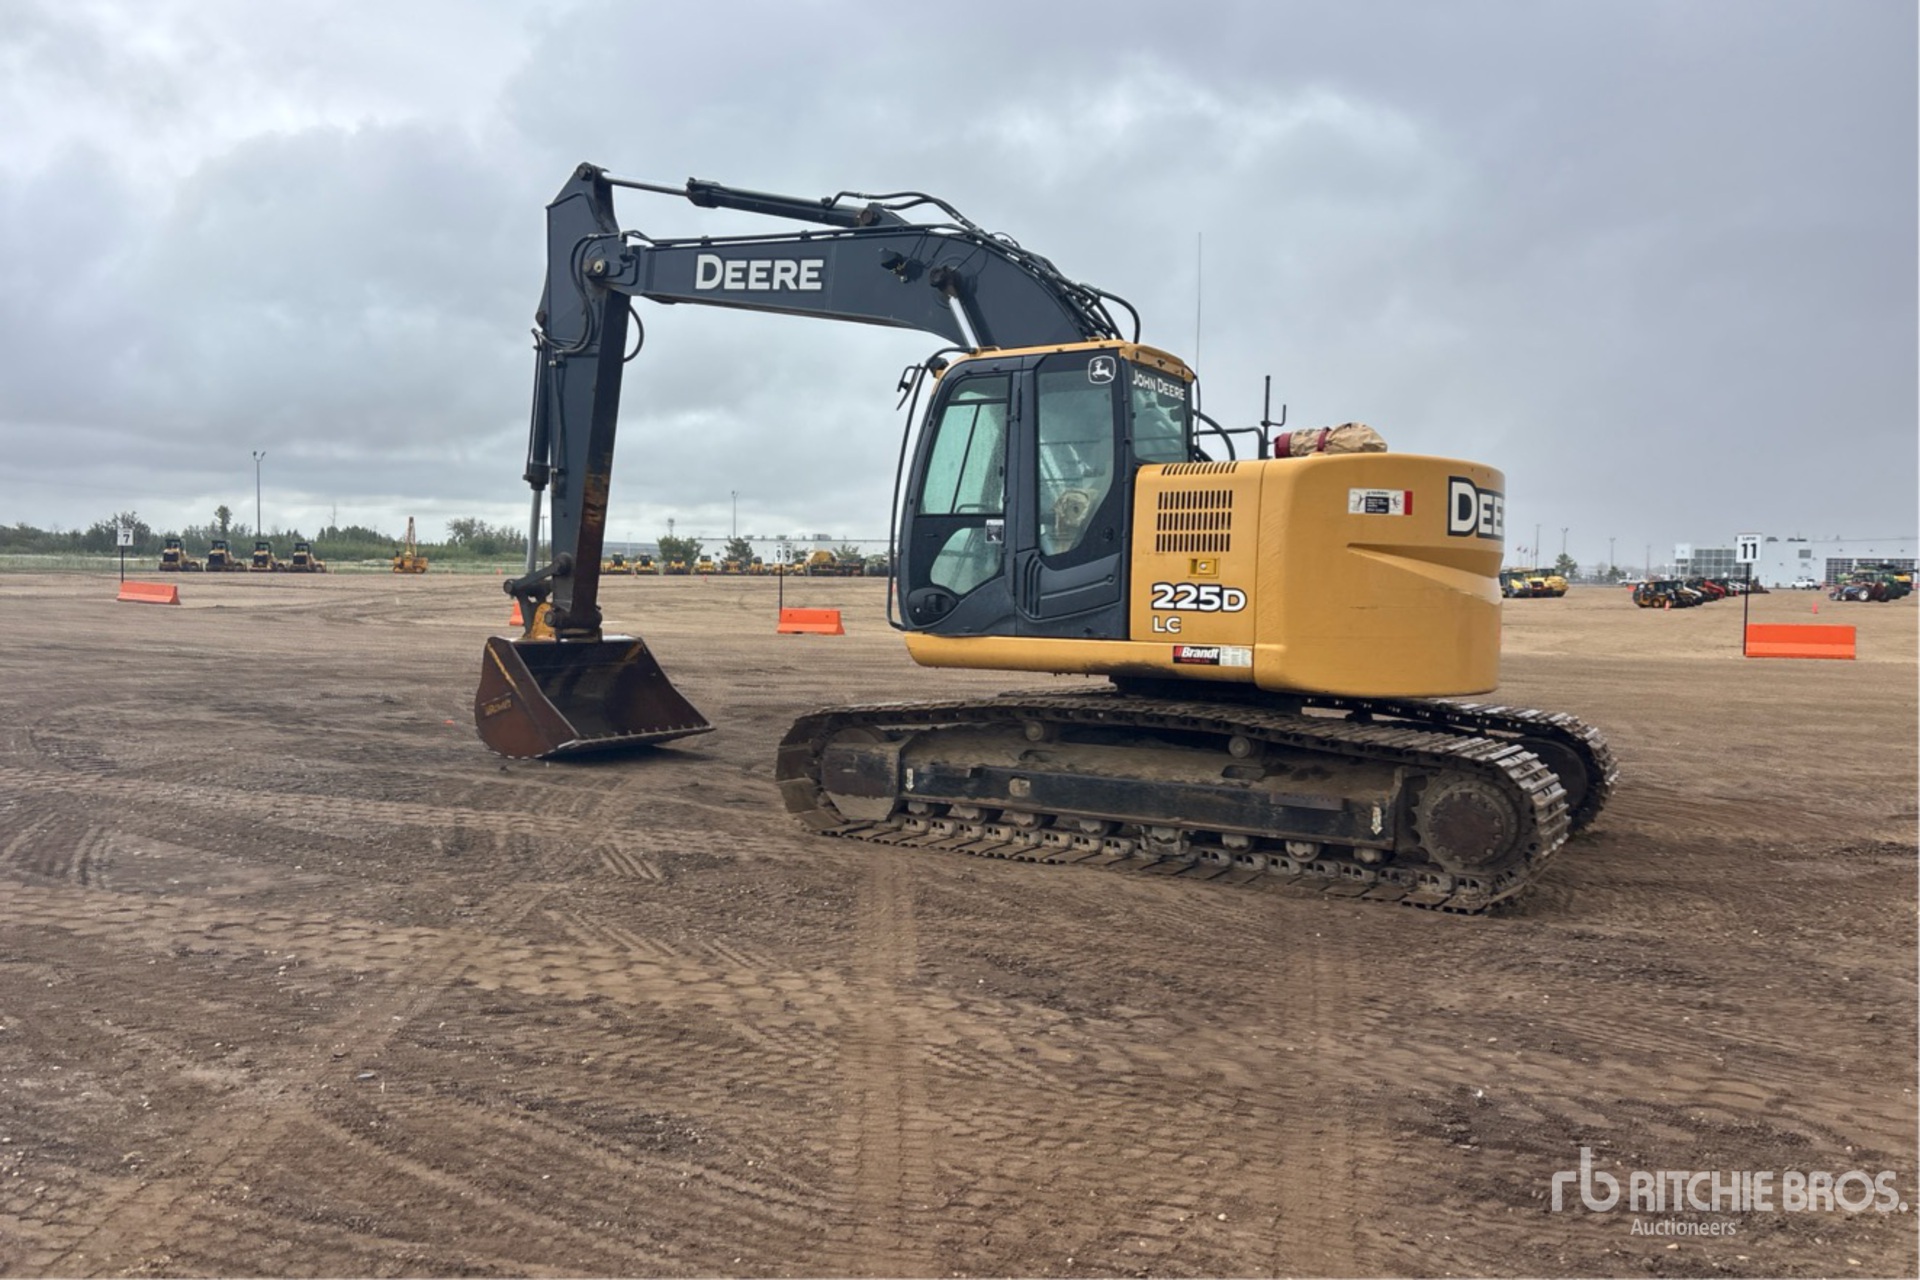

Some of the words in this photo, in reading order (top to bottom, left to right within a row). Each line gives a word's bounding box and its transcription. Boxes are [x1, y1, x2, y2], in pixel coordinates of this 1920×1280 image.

[695, 253, 824, 291] DEERE
[1132, 369, 1156, 391] JOHN
[1157, 377, 1186, 401] DEERE
[122, 533, 130, 544] 7
[1741, 542, 1757, 560] 11
[1152, 583, 1247, 612] 225D
[1153, 616, 1181, 633] LC
[1182, 646, 1219, 659] Brandt
